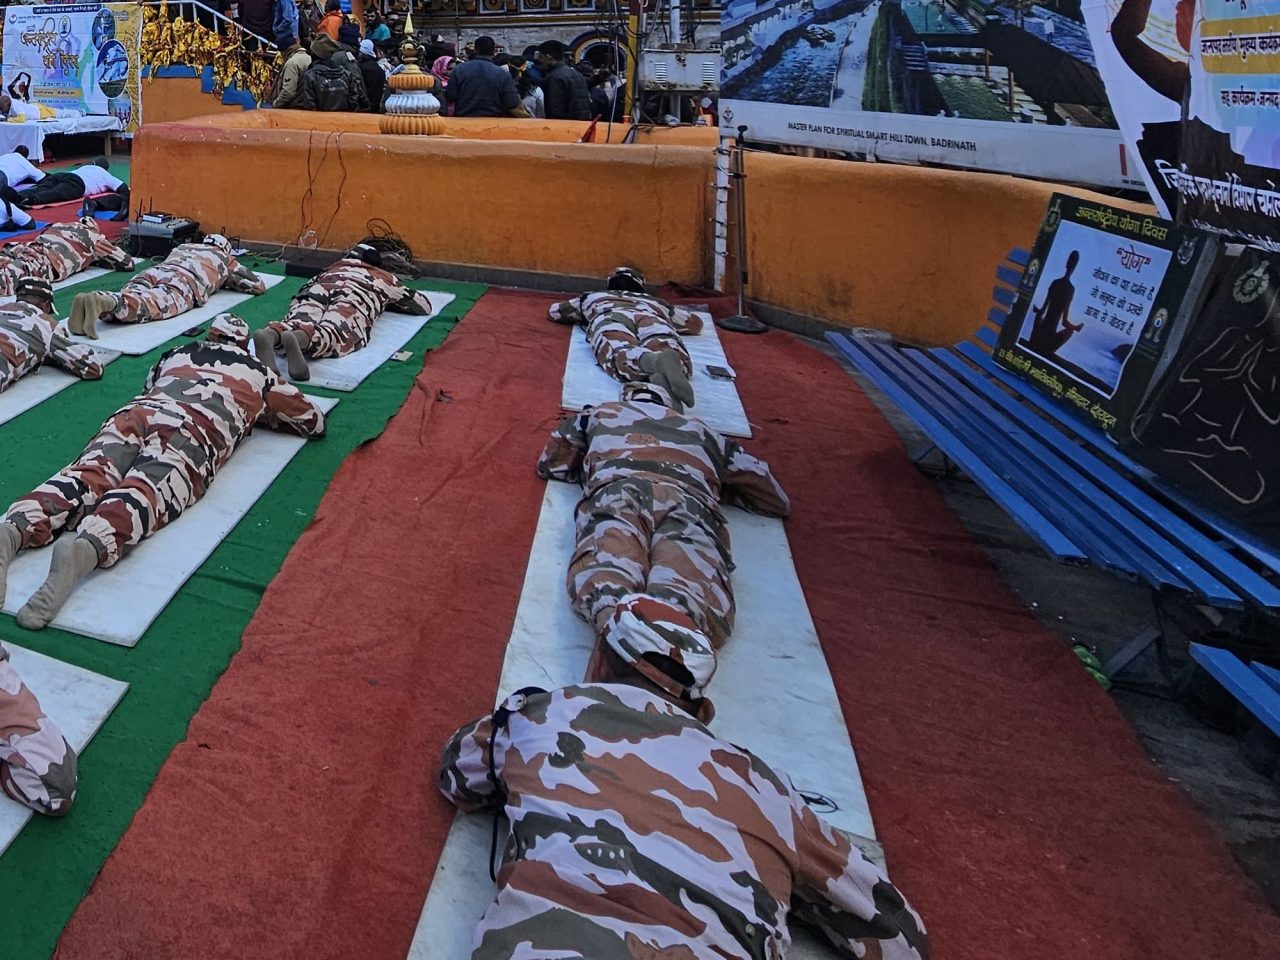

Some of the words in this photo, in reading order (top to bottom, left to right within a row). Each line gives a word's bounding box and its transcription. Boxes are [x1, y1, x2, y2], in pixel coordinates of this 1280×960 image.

[788, 122, 808, 131] MASTER
[808, 124, 823, 133] PLAN
[823, 126, 836, 135] FOR
[836, 127, 865, 139] SPIRITUAL
[865, 130, 889, 142] SMART
[889, 133, 904, 143] HILL
[931, 137, 977, 152] BADRINATH
[1142, 218, 1168, 241] दिवस
